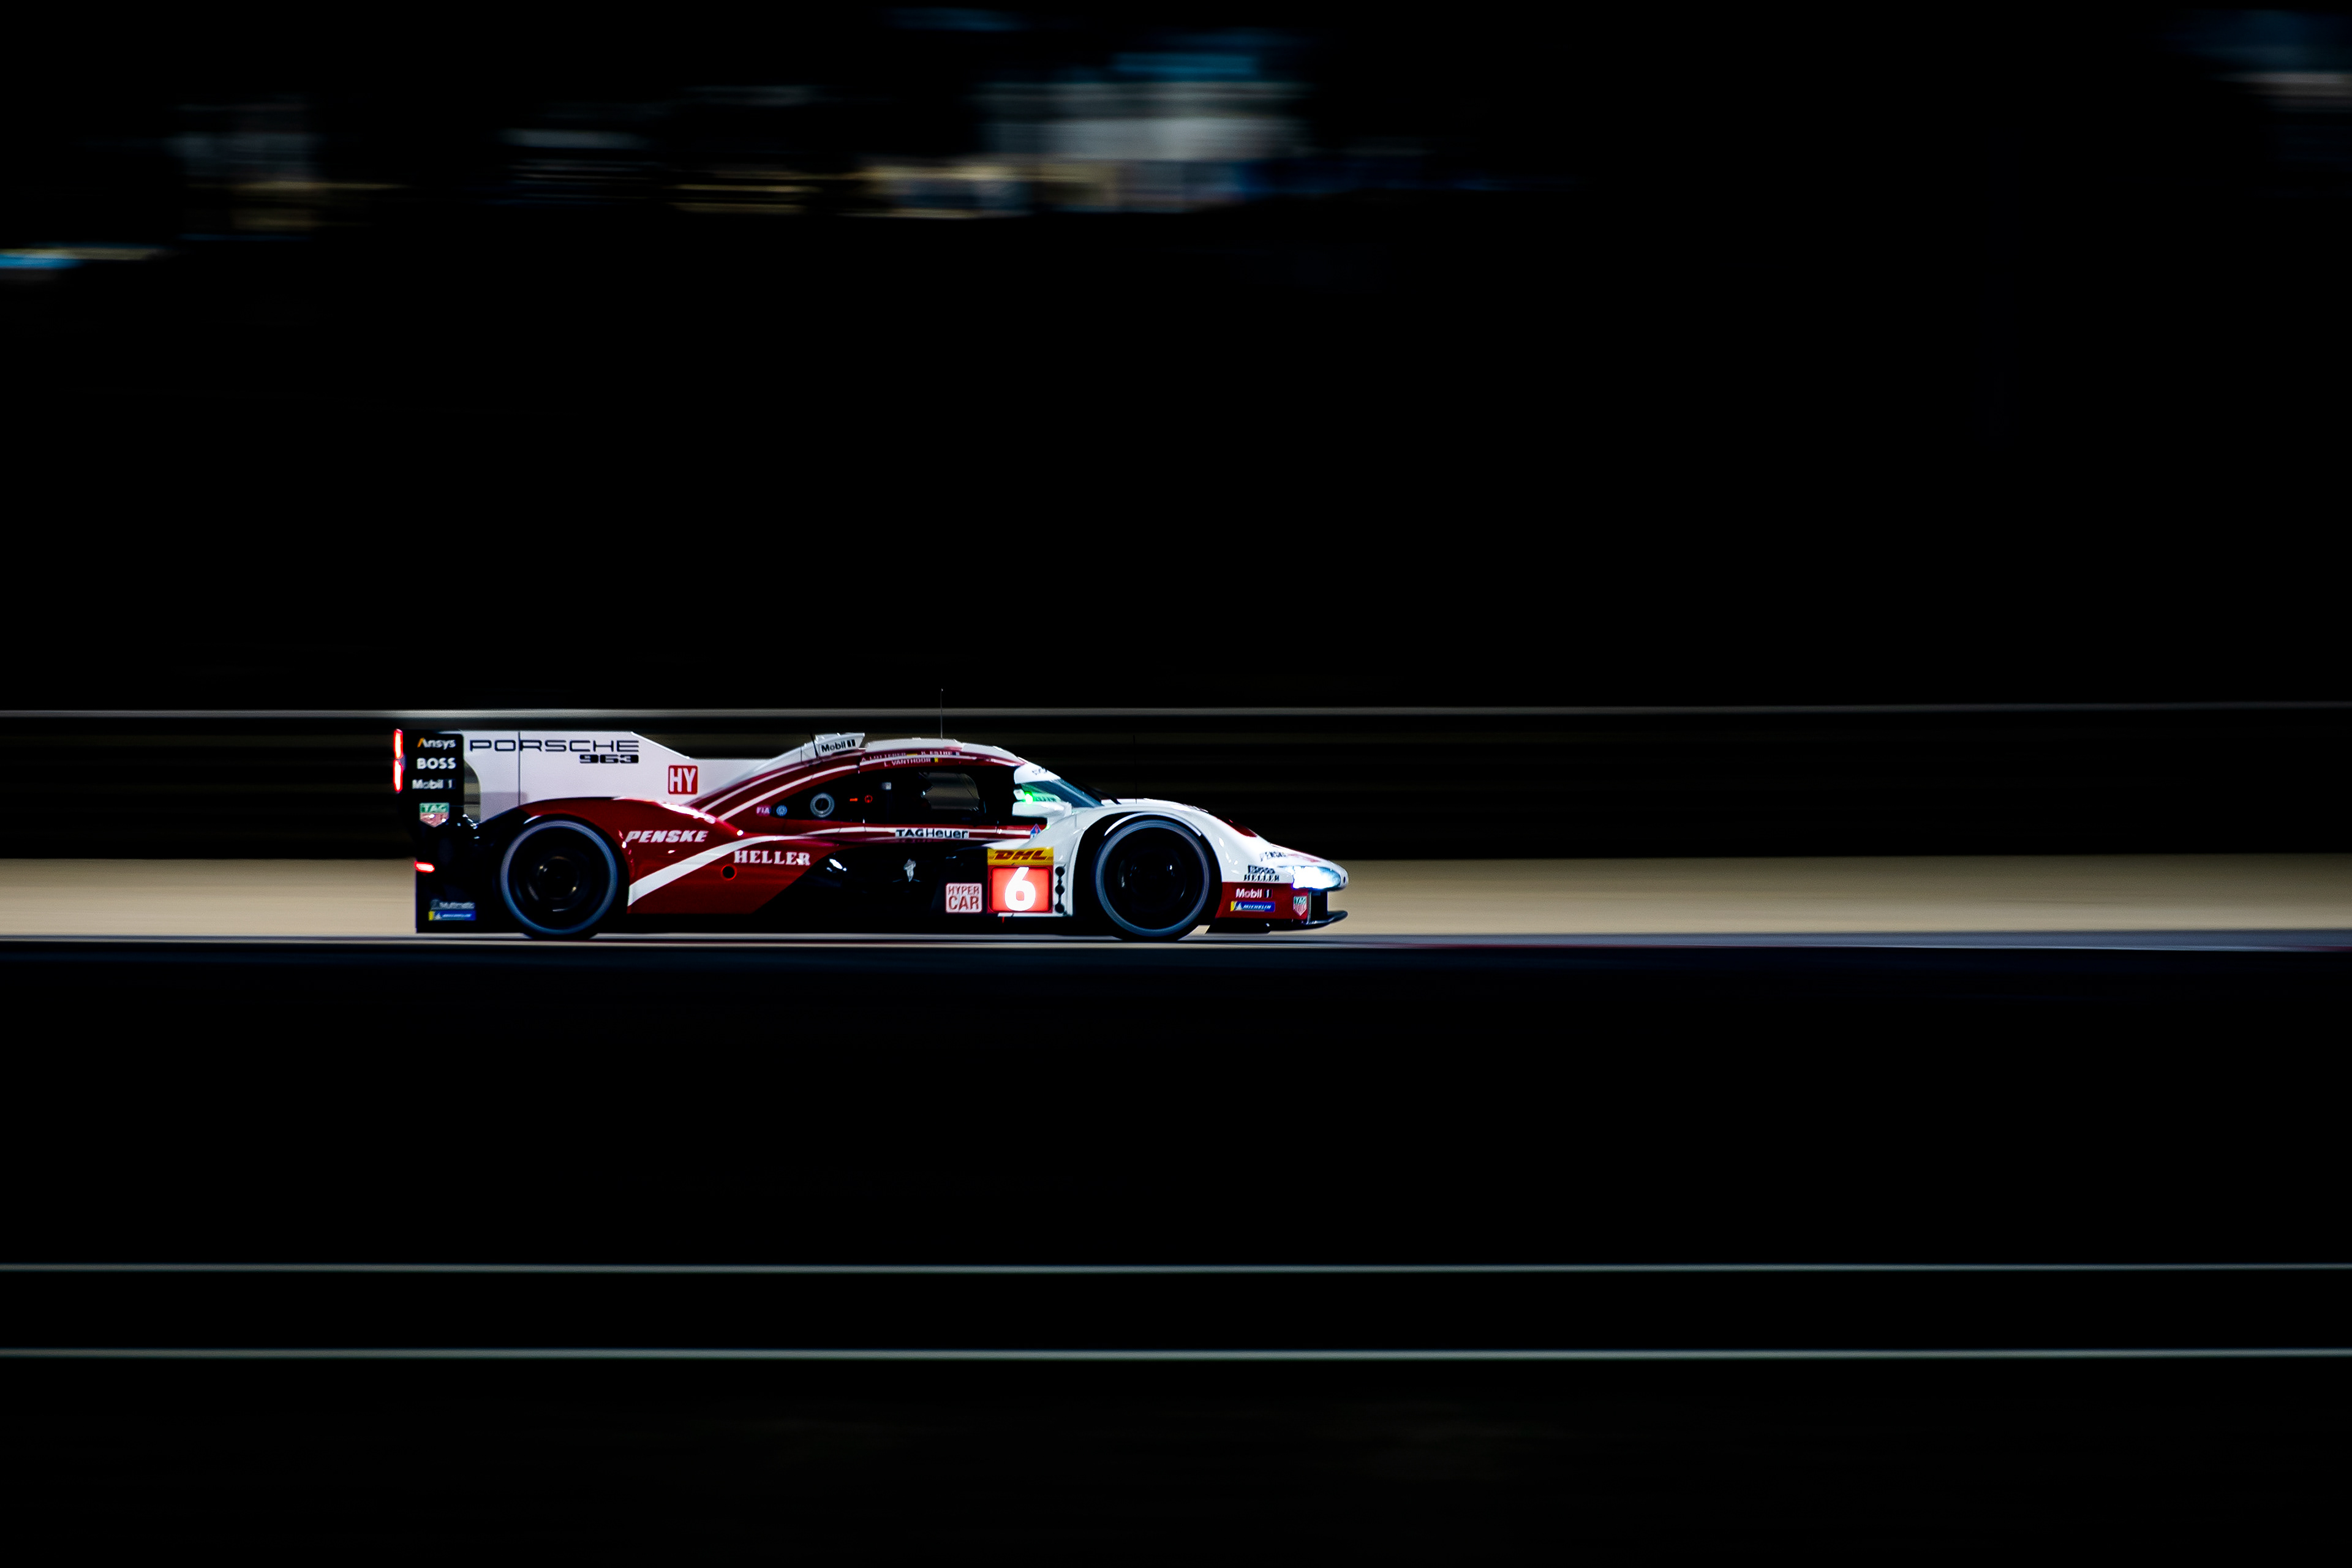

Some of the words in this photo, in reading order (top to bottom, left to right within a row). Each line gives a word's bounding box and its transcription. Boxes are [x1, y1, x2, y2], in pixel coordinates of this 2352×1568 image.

[417, 737, 456, 750] Ansys
[469, 739, 639, 752] PORSCHE
[821, 741, 846, 753] Mobil
[417, 758, 456, 769] BOSS
[579, 754, 639, 764] 963
[412, 779, 443, 790] Mobil
[669, 767, 696, 793] HY
[625, 830, 709, 843] PENSKE
[734, 850, 810, 865] HELLER
[994, 850, 1048, 860] DHL
[948, 886, 979, 895] HYPER
[1005, 867, 1036, 911] 6
[1235, 888, 1262, 899] Mobil
[949, 896, 979, 910] CAR
